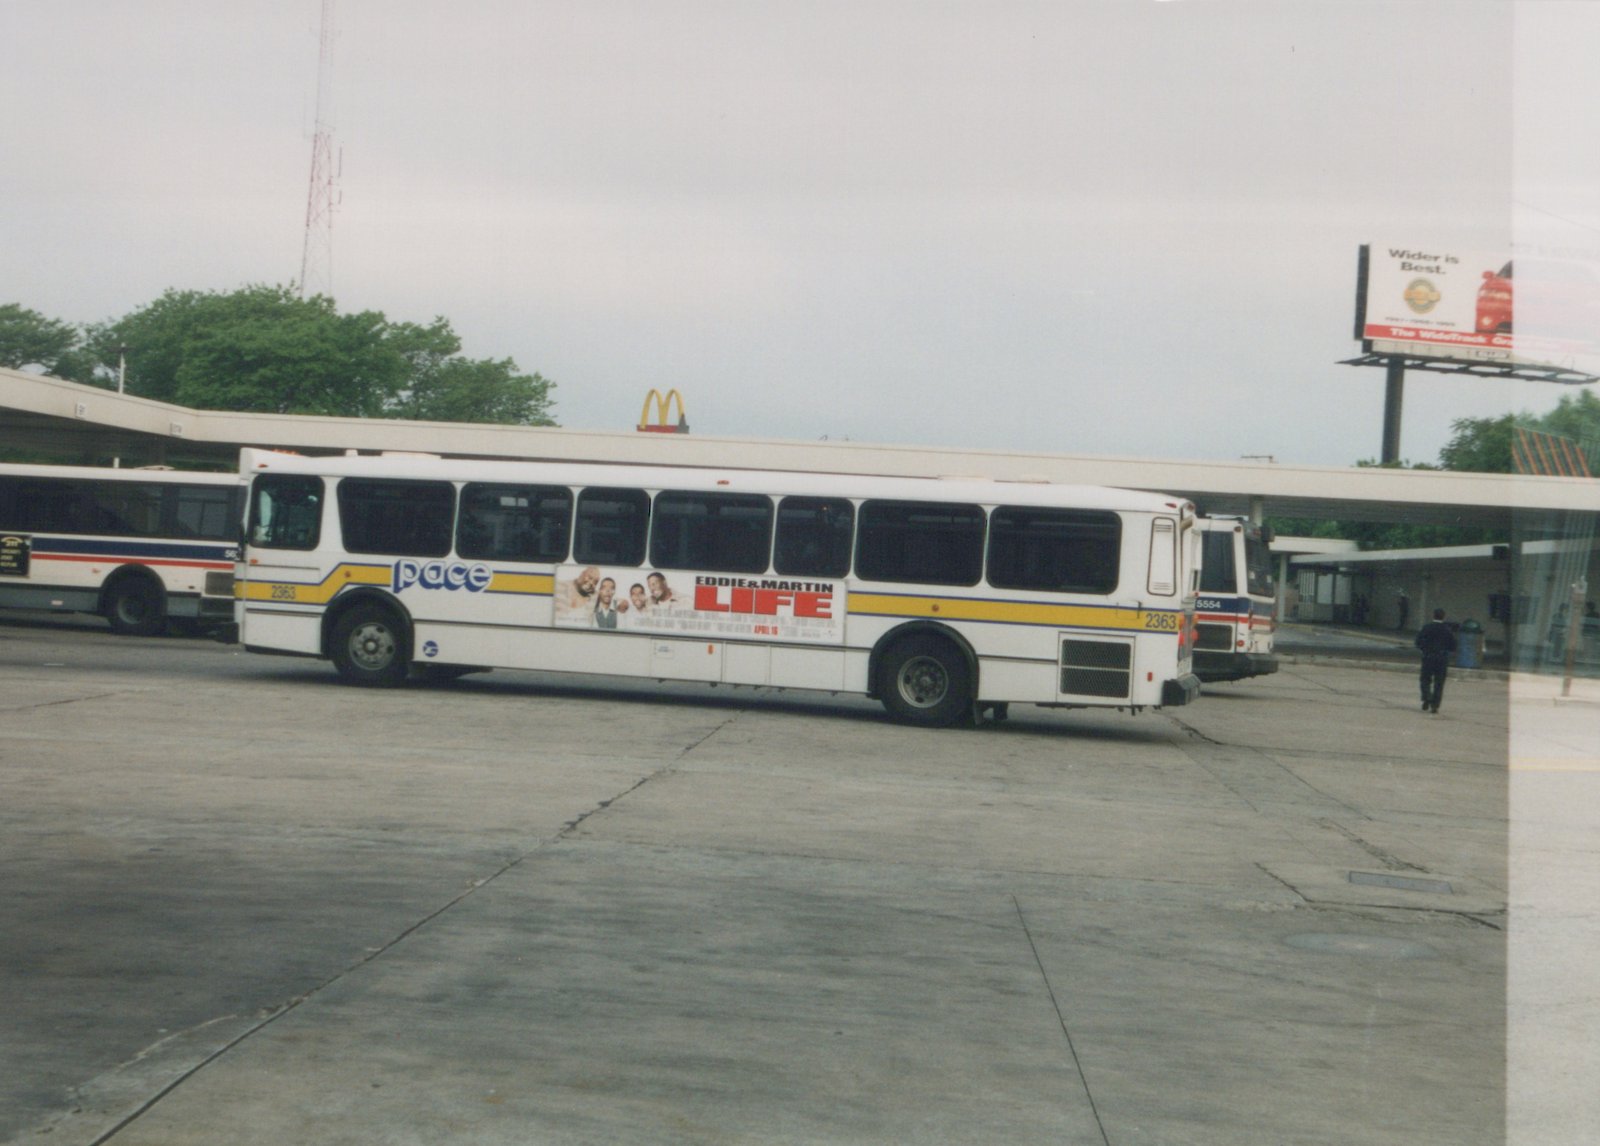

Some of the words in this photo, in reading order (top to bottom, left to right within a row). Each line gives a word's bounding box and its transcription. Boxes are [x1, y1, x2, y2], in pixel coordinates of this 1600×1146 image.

[1388, 248, 1441, 262] Wider
[1445, 253, 1460, 265] is
[1401, 261, 1446, 275] Best.
[1390, 327, 1416, 338] The
[392, 559, 494, 595] pace
[271, 584, 297, 600] 2363
[693, 584, 834, 619] LIFE
[1196, 600, 1221, 609] 5554
[1145, 612, 1177, 630] 2363
